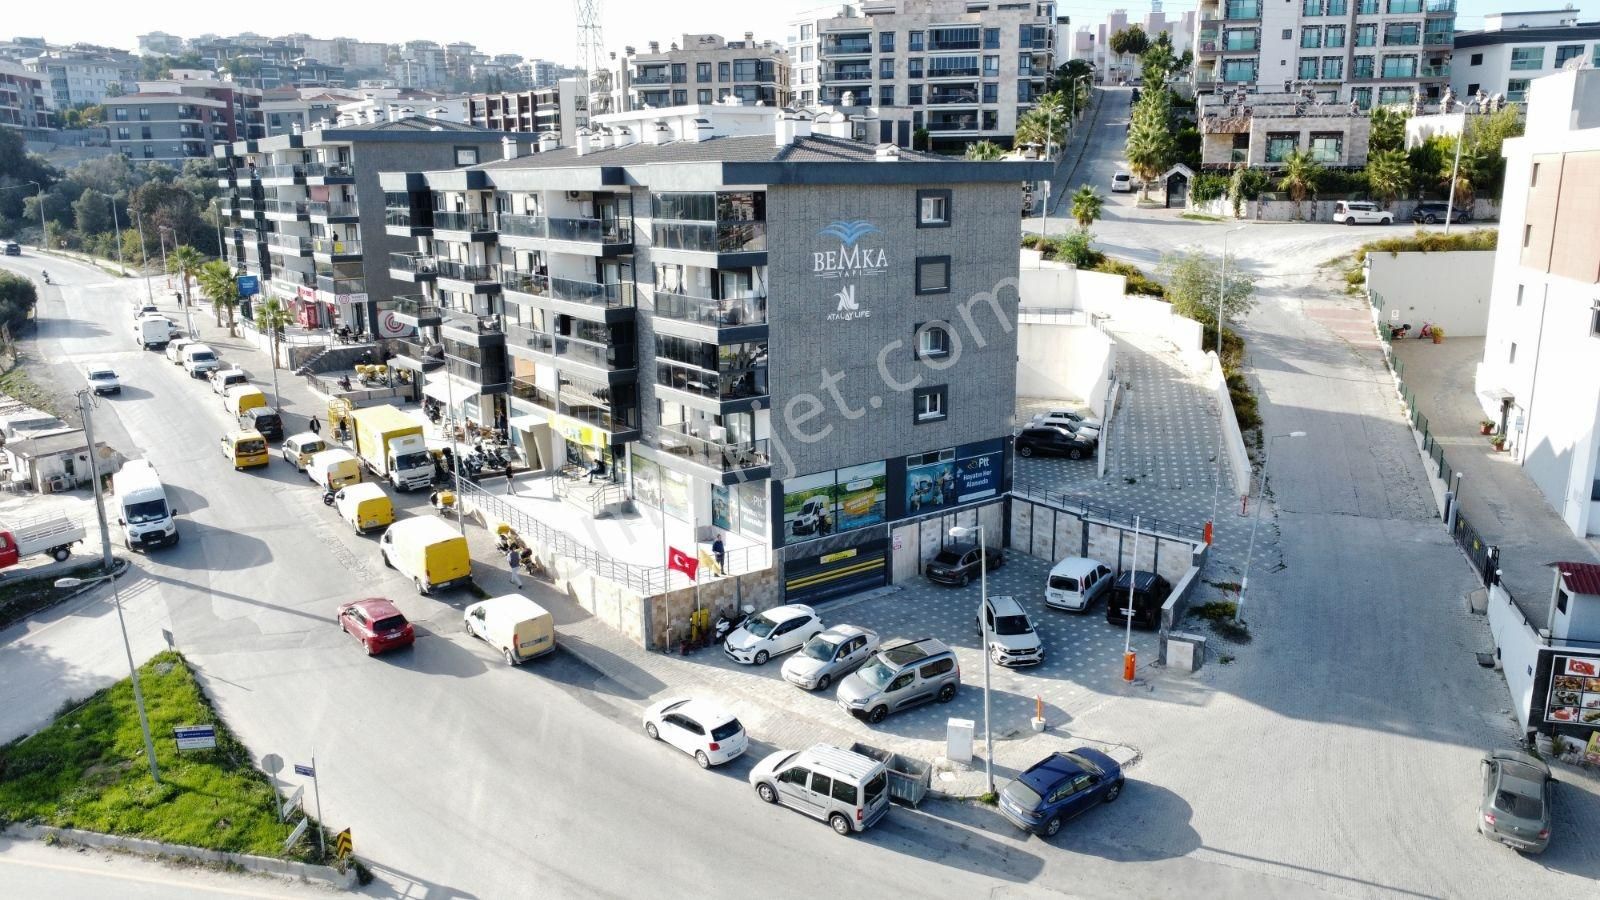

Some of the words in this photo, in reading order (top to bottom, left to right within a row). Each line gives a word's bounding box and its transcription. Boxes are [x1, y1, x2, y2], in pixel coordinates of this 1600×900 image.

[813, 244, 888, 271] BEMKA
[838, 270, 862, 278] YAPI
[826, 311, 853, 321] ATALAY
[854, 310, 871, 319] LIFE
[978, 456, 990, 468] Ptt
